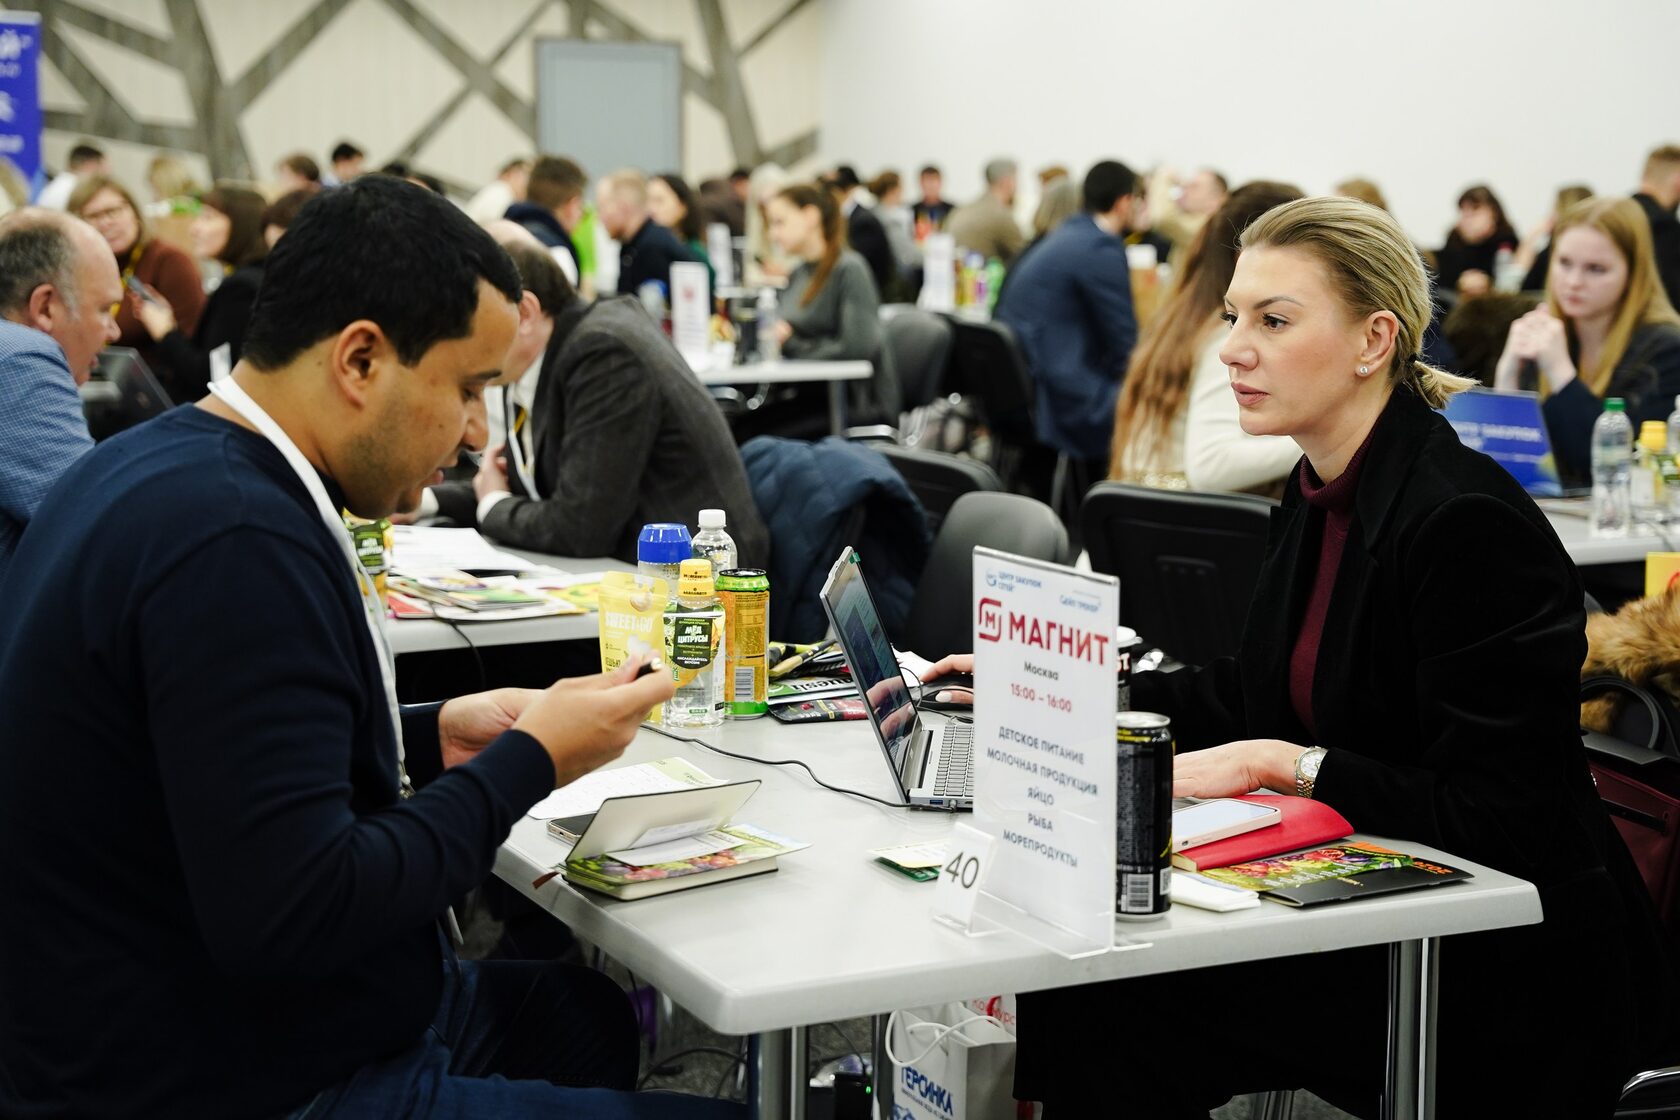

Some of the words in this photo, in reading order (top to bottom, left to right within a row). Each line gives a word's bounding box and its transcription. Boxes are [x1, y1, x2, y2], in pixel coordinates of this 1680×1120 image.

[677, 635, 709, 644] ЦИТРУСЫ
[1009, 611, 1109, 665] МАГНИТ
[1024, 661, 1059, 681] Москва
[1011, 683, 1036, 701] 15:00
[1047, 694, 1072, 713] 16:00
[998, 726, 1039, 750] ДЕТСКОЕ
[1041, 740, 1084, 765] ПИТАНИЕ
[987, 747, 1038, 773] МОЛОЧНАЯ
[1040, 766, 1098, 796] ПРОДУКЦИЯ
[1027, 787, 1055, 806] ЯЙЦО
[1028, 812, 1053, 832] РЫБА
[1003, 829, 1078, 868] МОРЕПРОДУКТЫ
[945, 851, 979, 889] 40
